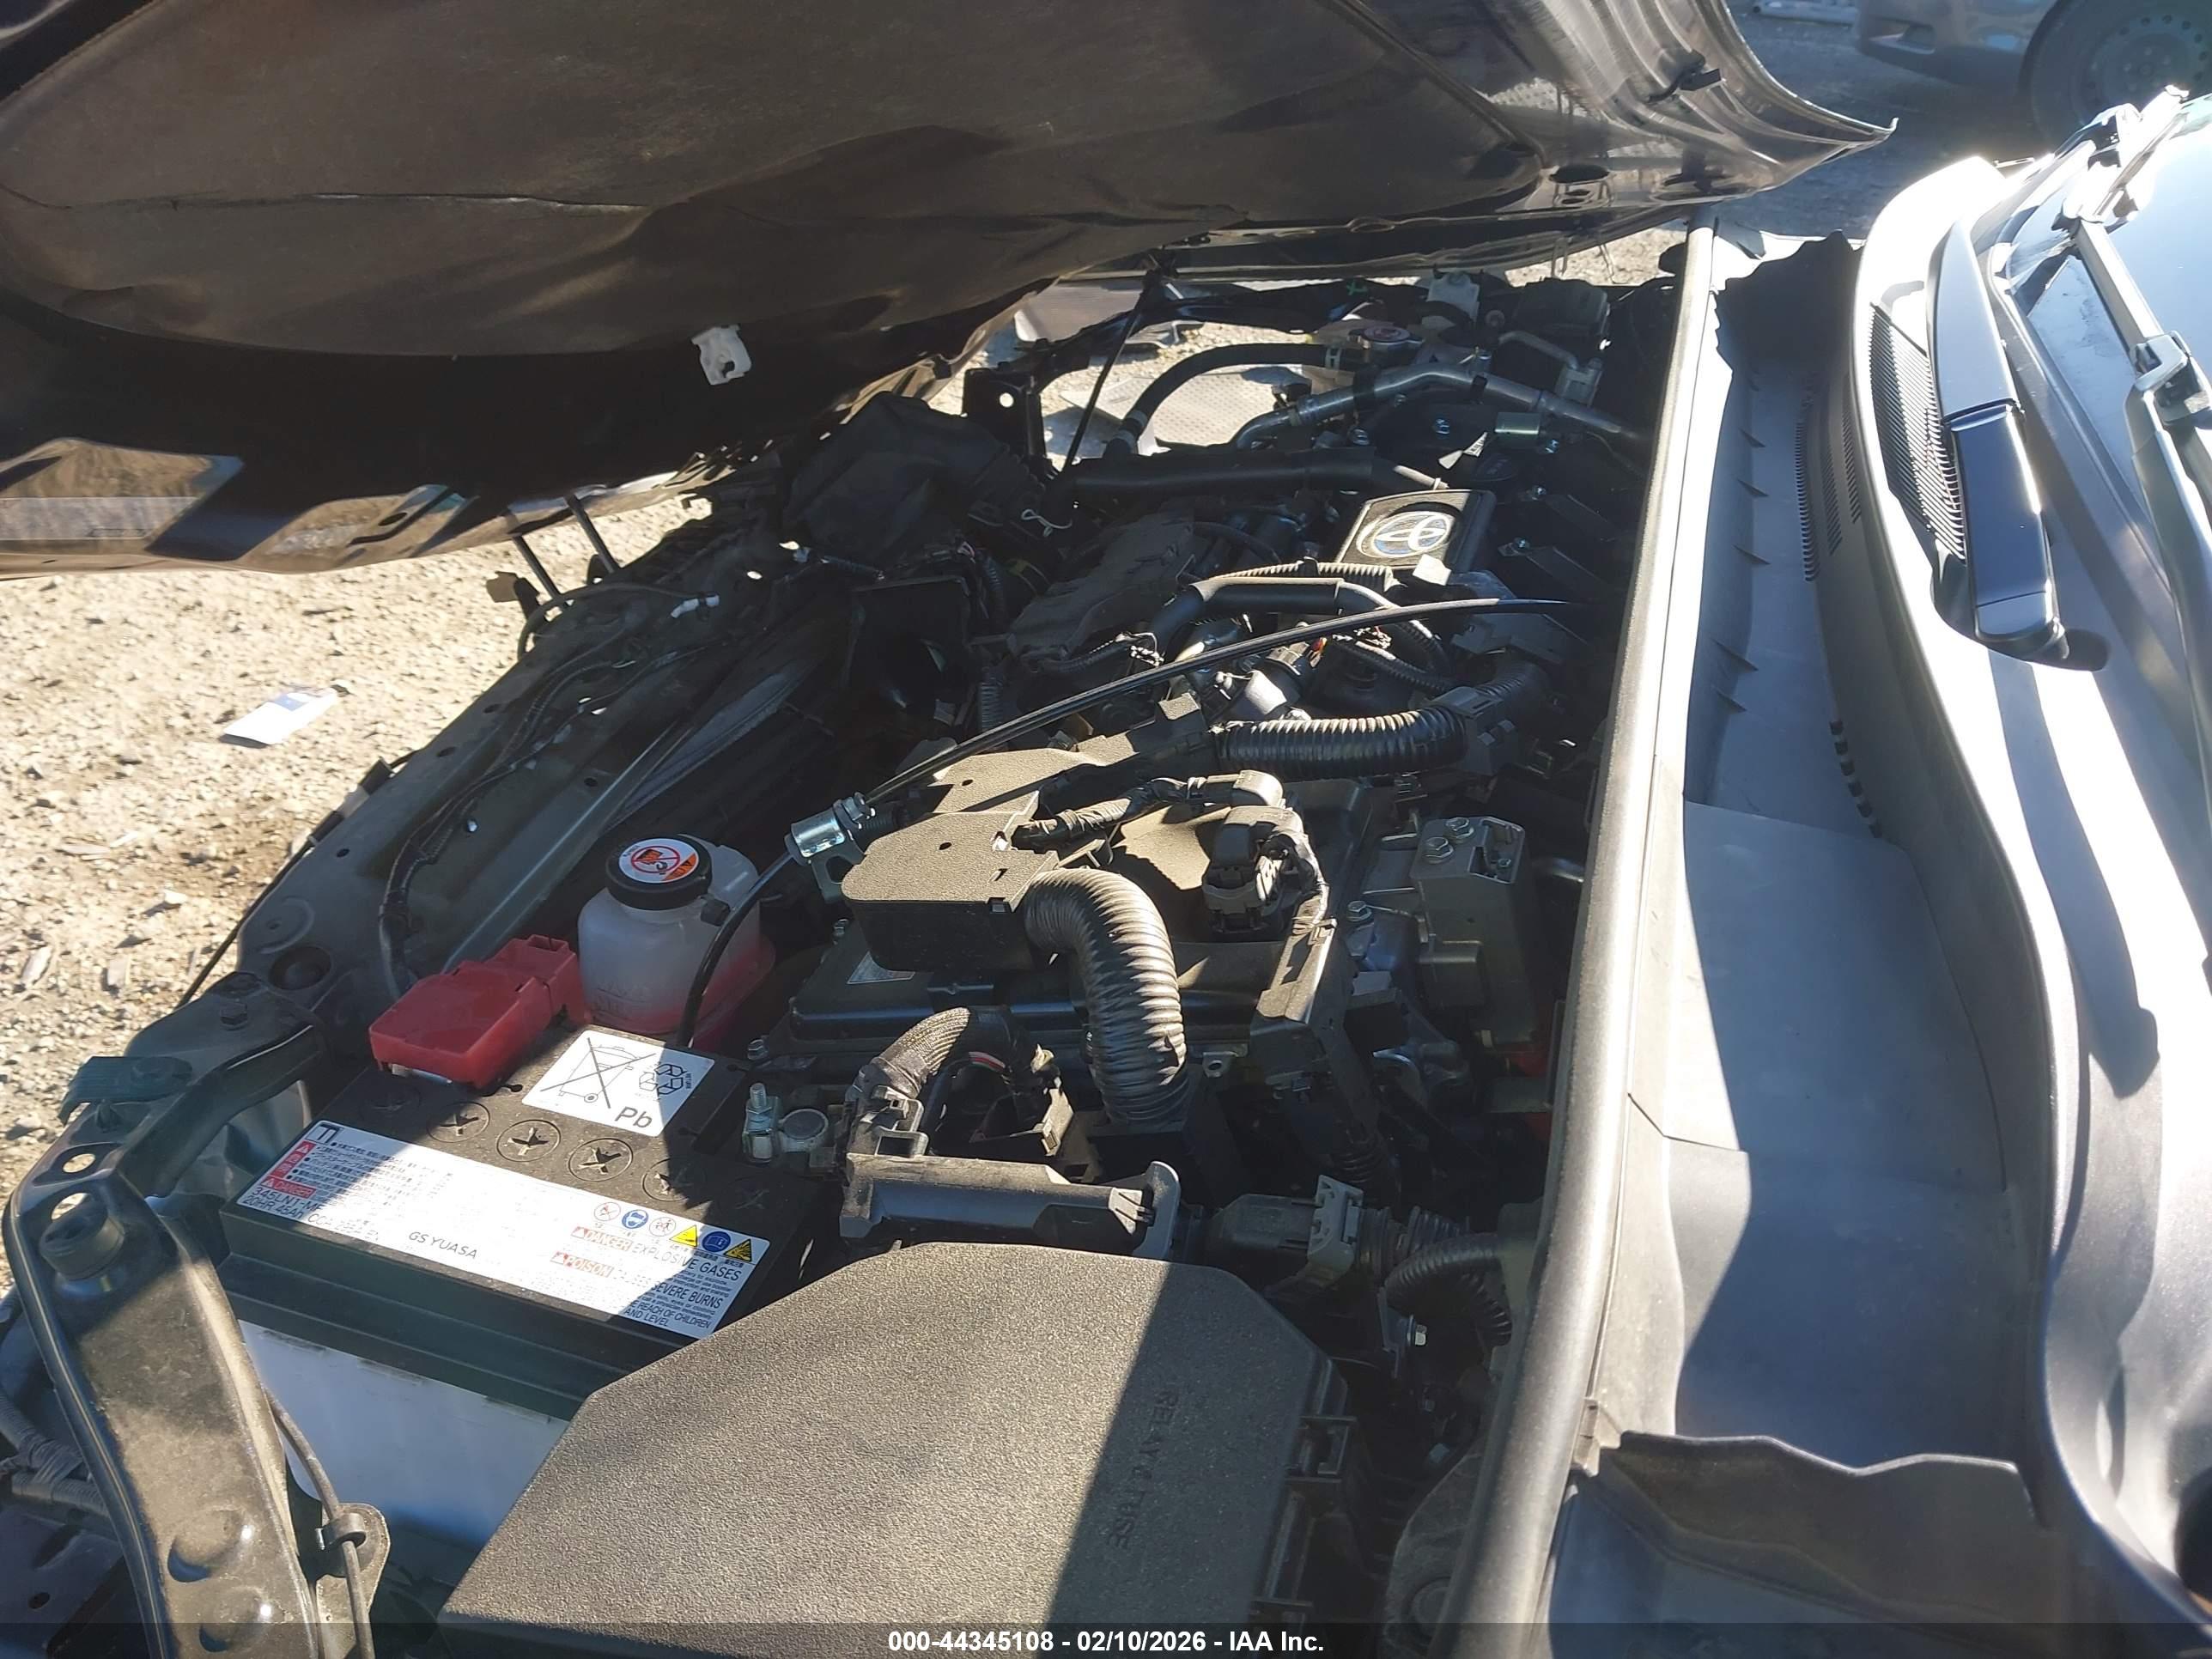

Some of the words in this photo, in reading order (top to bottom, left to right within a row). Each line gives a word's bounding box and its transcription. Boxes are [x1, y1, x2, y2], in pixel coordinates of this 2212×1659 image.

[614, 1106, 653, 1128] Pb
[409, 1231, 429, 1243] GS
[430, 1237, 477, 1259] YUASA
[586, 1229, 632, 1251] DANGER
[632, 1243, 699, 1269] EXPLOSIVE
[698, 1261, 743, 1281] GASES
[565, 1255, 612, 1277] POISON
[688, 1291, 724, 1309] BURNS
[624, 1307, 644, 1319] AND
[643, 1313, 671, 1327] LEVEL
[637, 1302, 665, 1315] REACH
[663, 1310, 676, 1319] OF
[673, 1312, 712, 1328] CHILDREN
[1139, 1389, 1180, 1459] RELAY
